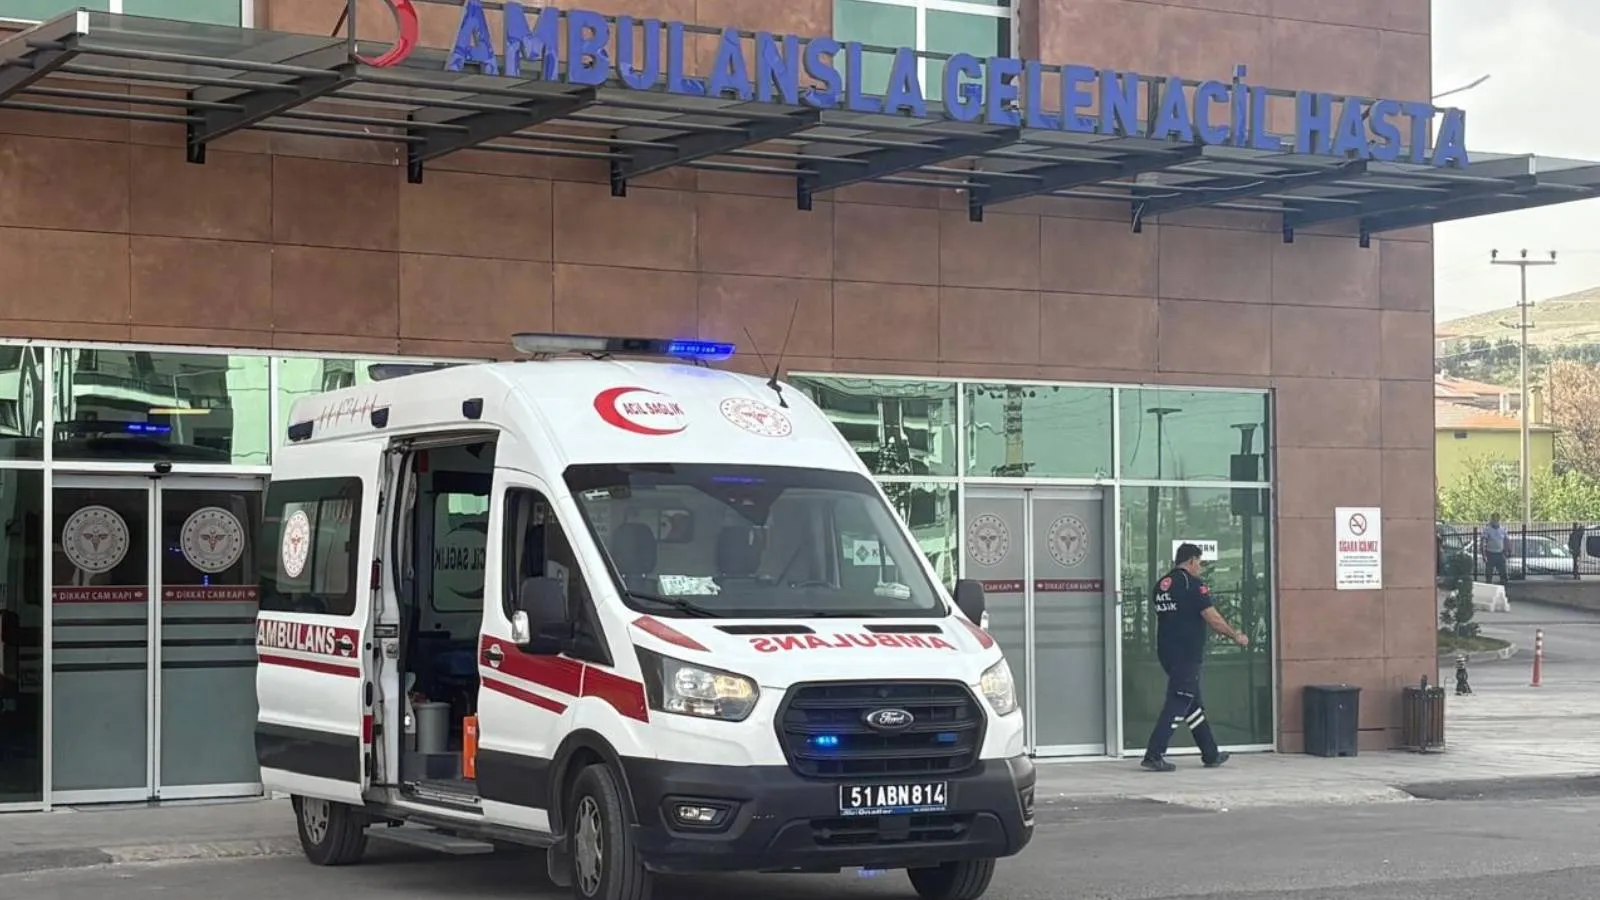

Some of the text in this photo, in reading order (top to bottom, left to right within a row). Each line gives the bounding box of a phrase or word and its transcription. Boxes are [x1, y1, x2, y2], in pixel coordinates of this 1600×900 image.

[446, 0, 1469, 168] AMBULANSLA GELEN ACİL HASTA
[59, 591, 132, 601] DİKKAT CAM KAPI
[176, 590, 245, 600] DİKKAT CAM KAPI
[257, 620, 336, 655] AMBULANS
[879, 711, 905, 725] Ford
[851, 783, 944, 807] 51 ABN 814
